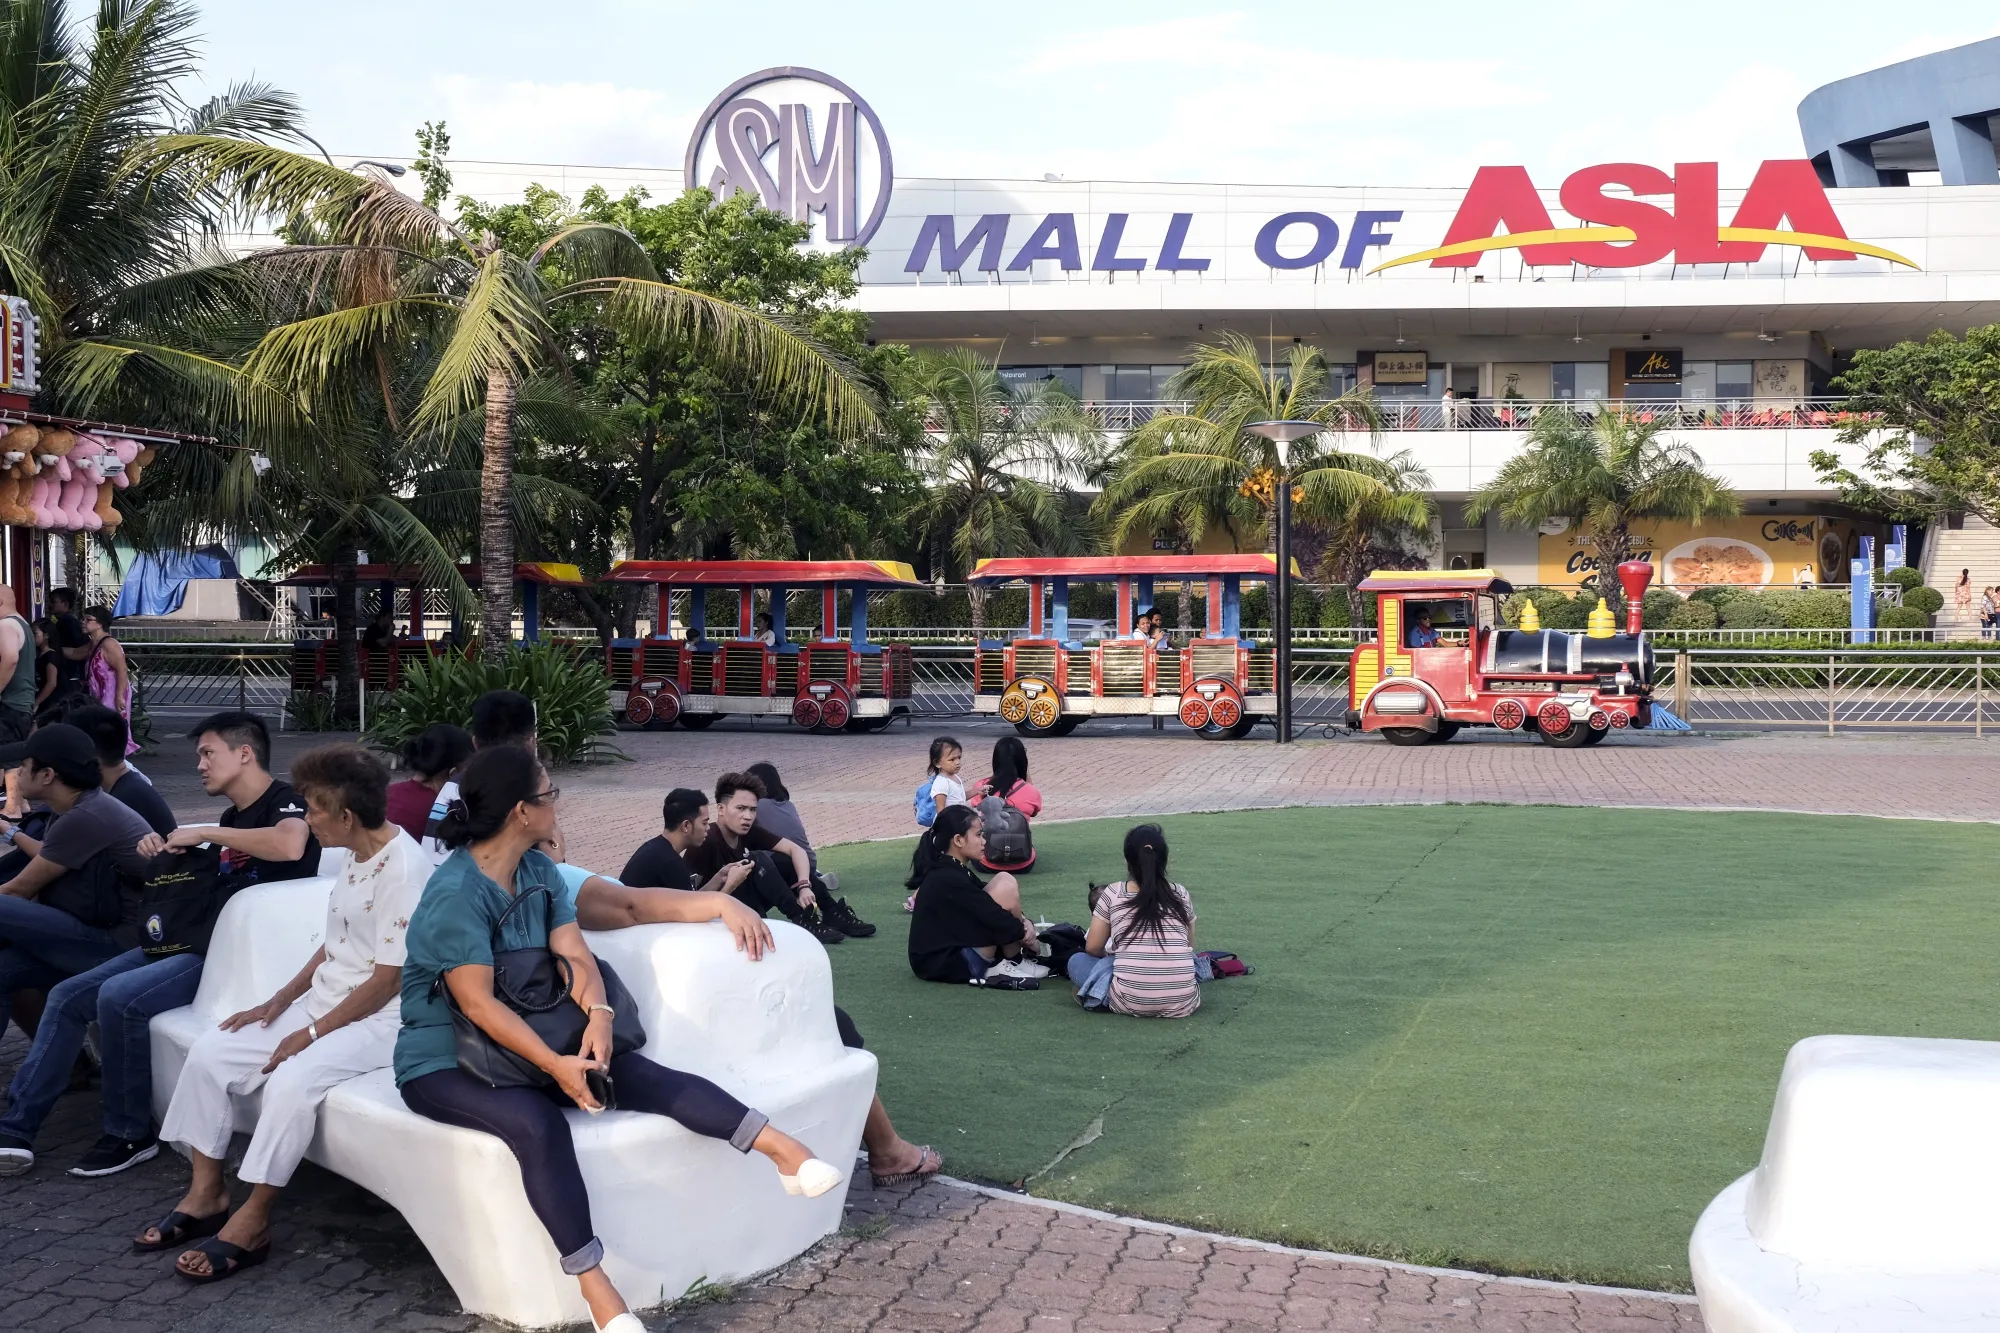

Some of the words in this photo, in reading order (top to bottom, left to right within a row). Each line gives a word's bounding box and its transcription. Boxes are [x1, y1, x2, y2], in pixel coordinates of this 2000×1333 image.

[708, 98, 857, 243] SM
[904, 212, 1212, 272] MALL
[1254, 210, 1404, 270] OF
[1428, 159, 1858, 269] ASIA
